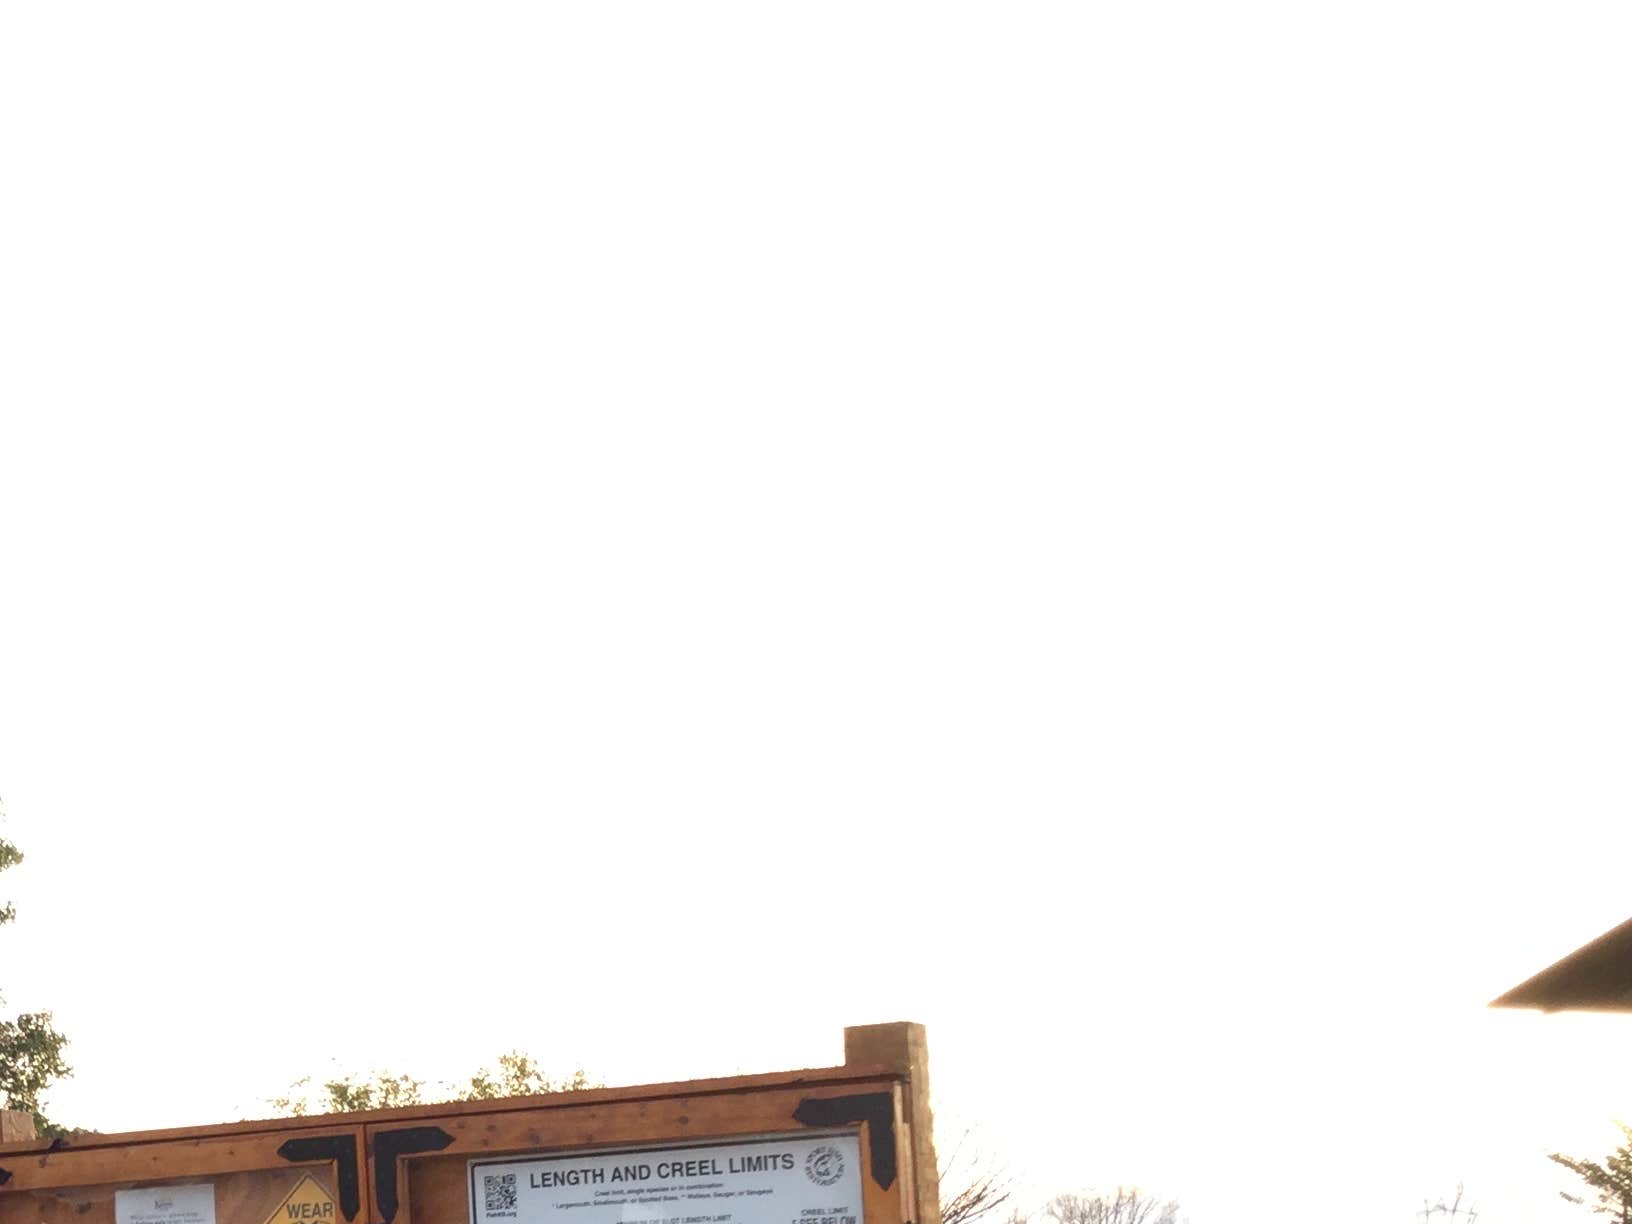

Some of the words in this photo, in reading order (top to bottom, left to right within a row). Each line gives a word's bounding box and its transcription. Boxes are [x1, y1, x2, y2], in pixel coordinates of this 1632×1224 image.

[529, 1167, 605, 1189] LENGTH
[611, 1164, 651, 1182] AND
[657, 1158, 723, 1179] CREEL
[729, 1153, 795, 1174] LIMITS
[287, 1202, 334, 1219] WEAR
